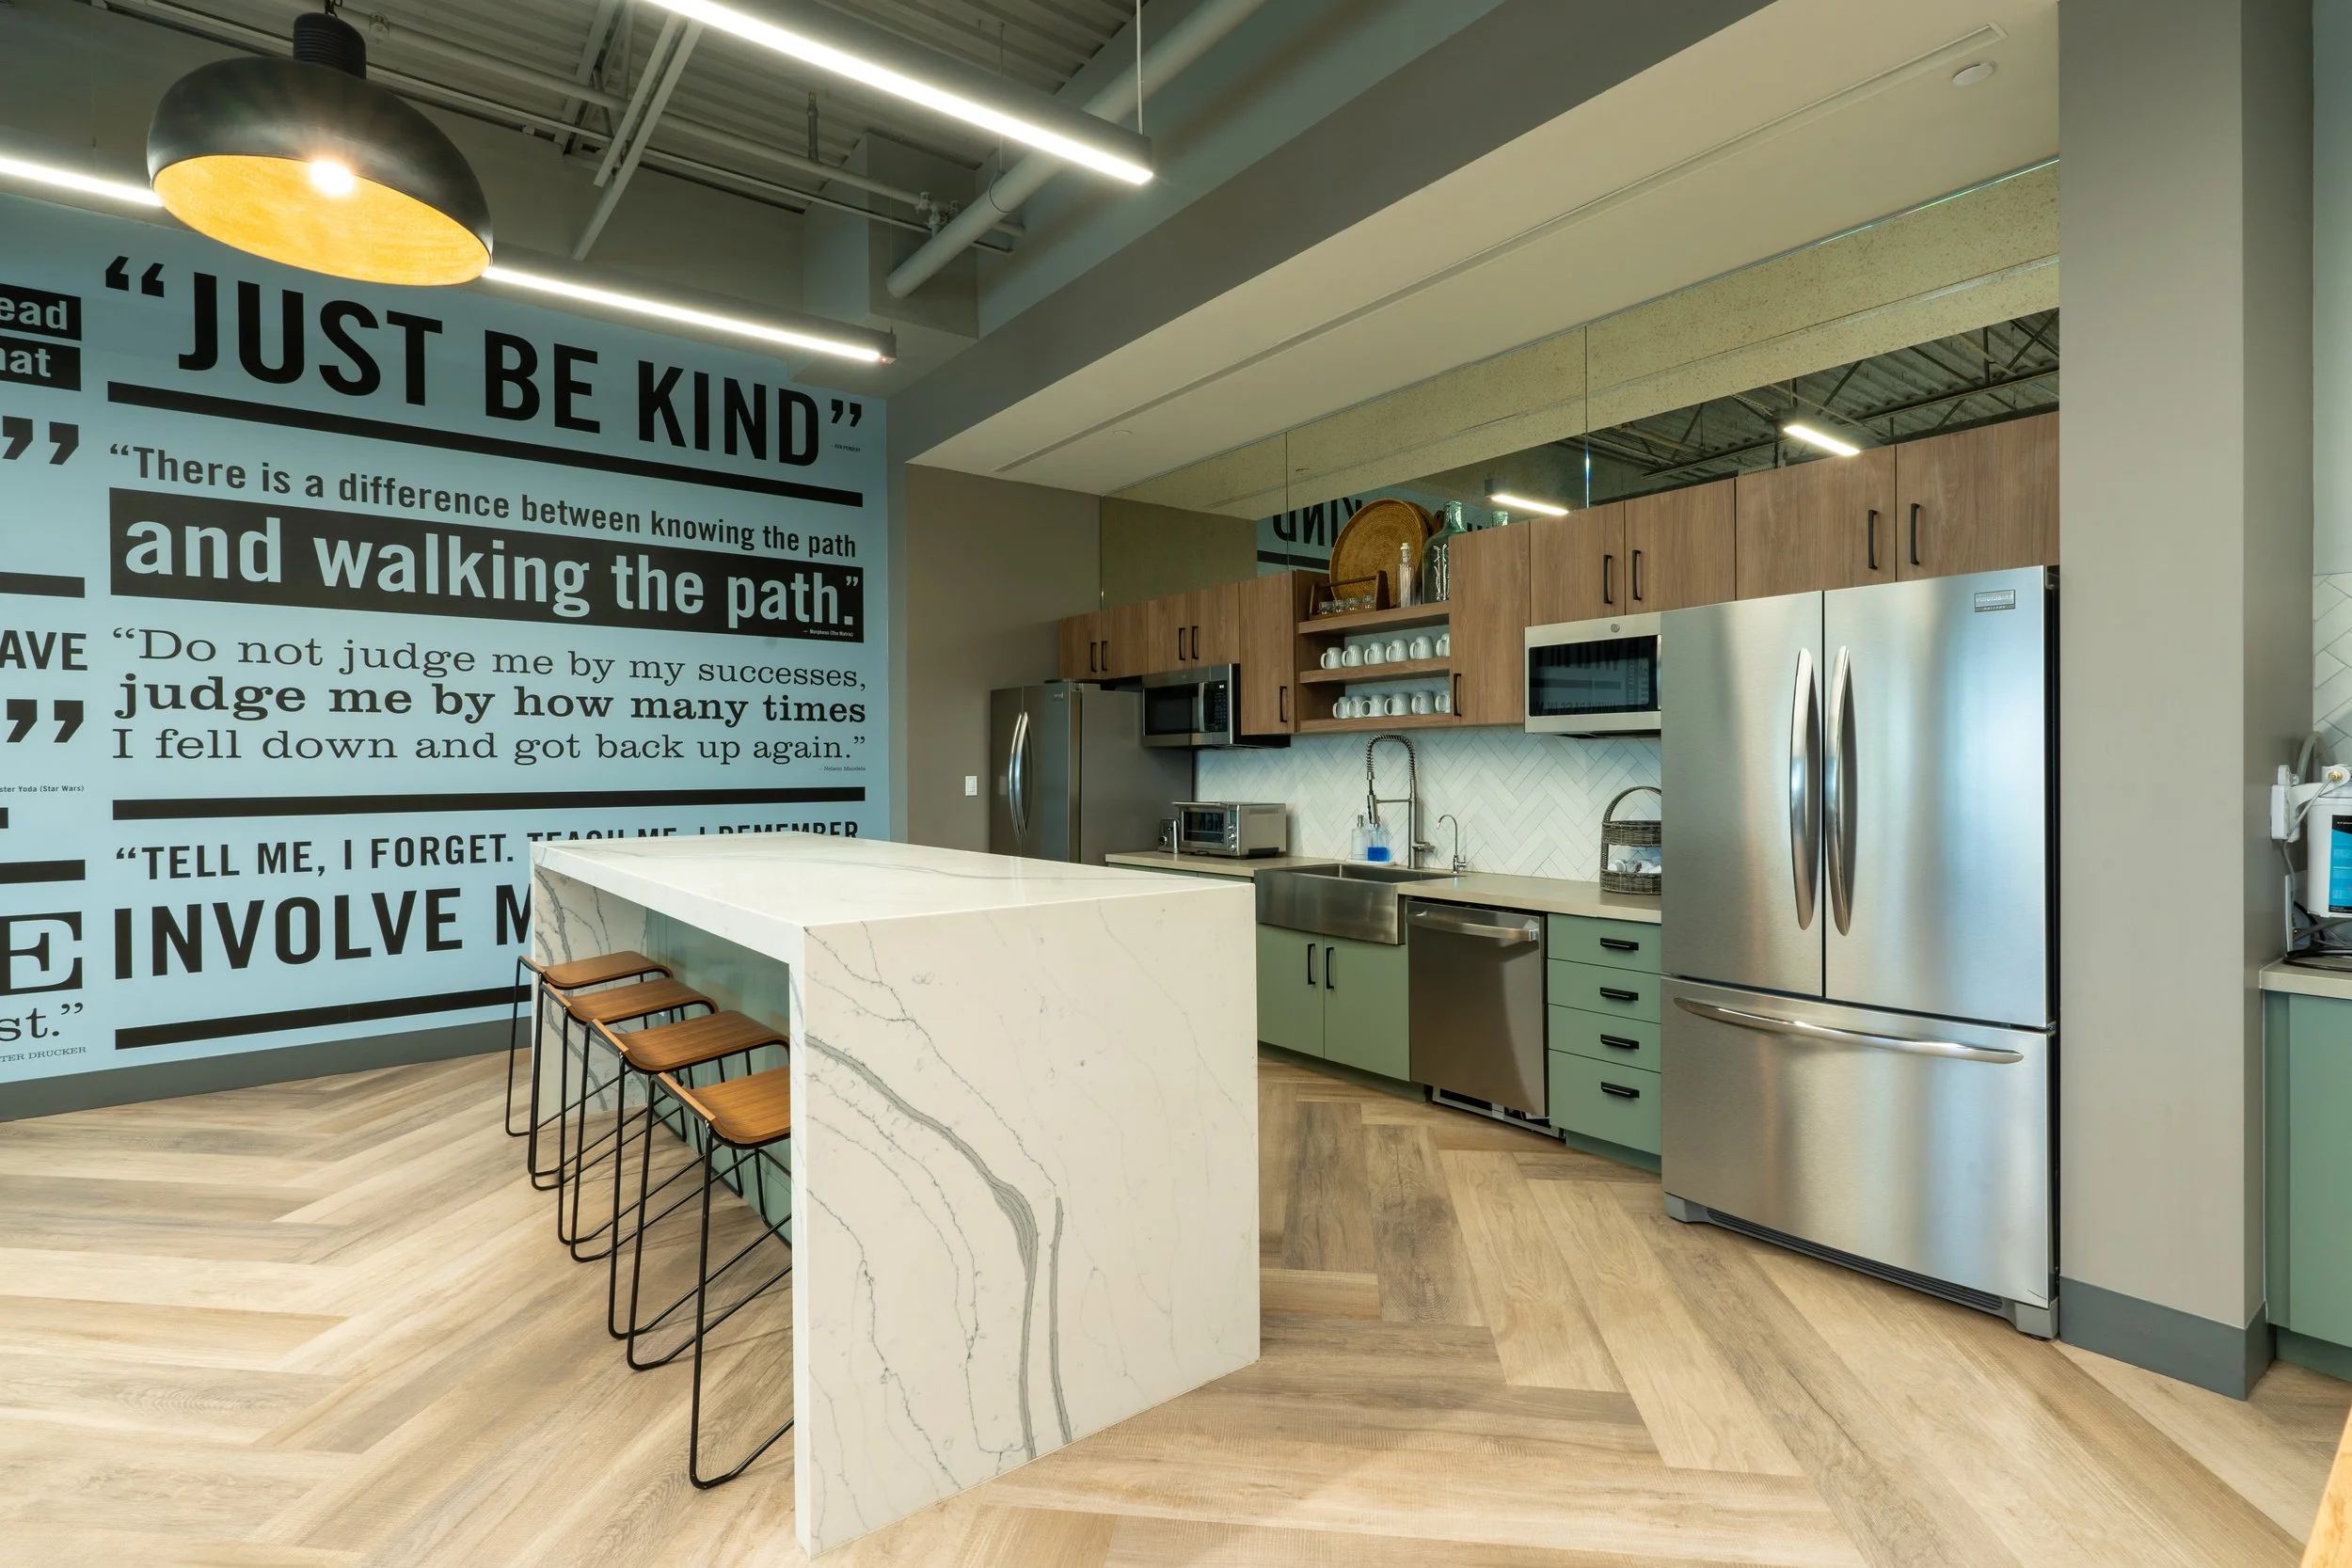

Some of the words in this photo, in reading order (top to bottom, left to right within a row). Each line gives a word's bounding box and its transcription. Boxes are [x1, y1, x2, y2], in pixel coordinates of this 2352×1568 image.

[104, 255, 443, 407] “JUST
[484, 329, 601, 435] BE
[638, 359, 863, 467] KIND”
[110, 443, 246, 489] “There
[262, 462, 291, 494] is
[305, 474, 324, 499] a
[339, 472, 509, 519] difference
[521, 494, 641, 533] between
[651, 510, 755, 551] knowing
[762, 525, 800, 551] the
[808, 534, 856, 559] path
[124, 515, 282, 584] and
[312, 532, 591, 618] walking
[610, 553, 704, 614] the
[727, 572, 859, 629] path.”
[113, 626, 216, 662] “Do
[237, 638, 324, 666] not
[339, 639, 475, 678] judge
[491, 654, 553, 675] me
[567, 650, 616, 684] by
[628, 660, 686, 687] my
[698, 663, 866, 691] successes,
[114, 673, 306, 721] judge
[328, 689, 412, 715] me
[431, 683, 496, 724] by
[513, 685, 614, 718] how
[630, 697, 750, 729] many
[762, 694, 866, 723] times
[112, 728, 134, 759] I
[155, 728, 242, 759] fell
[262, 730, 398, 759] down
[415, 732, 499, 759] and
[514, 734, 580, 766] got
[595, 733, 685, 759] back
[696, 740, 740, 766] up
[753, 736, 866, 765] again.”
[116, 844, 240, 880] “TELL
[257, 841, 326, 877] ME,
[344, 839, 352, 870] I
[371, 833, 514, 869] FORGET.
[114, 887, 463, 980] INVOLVE
[28, 1046, 87, 1060] DRUCKER
